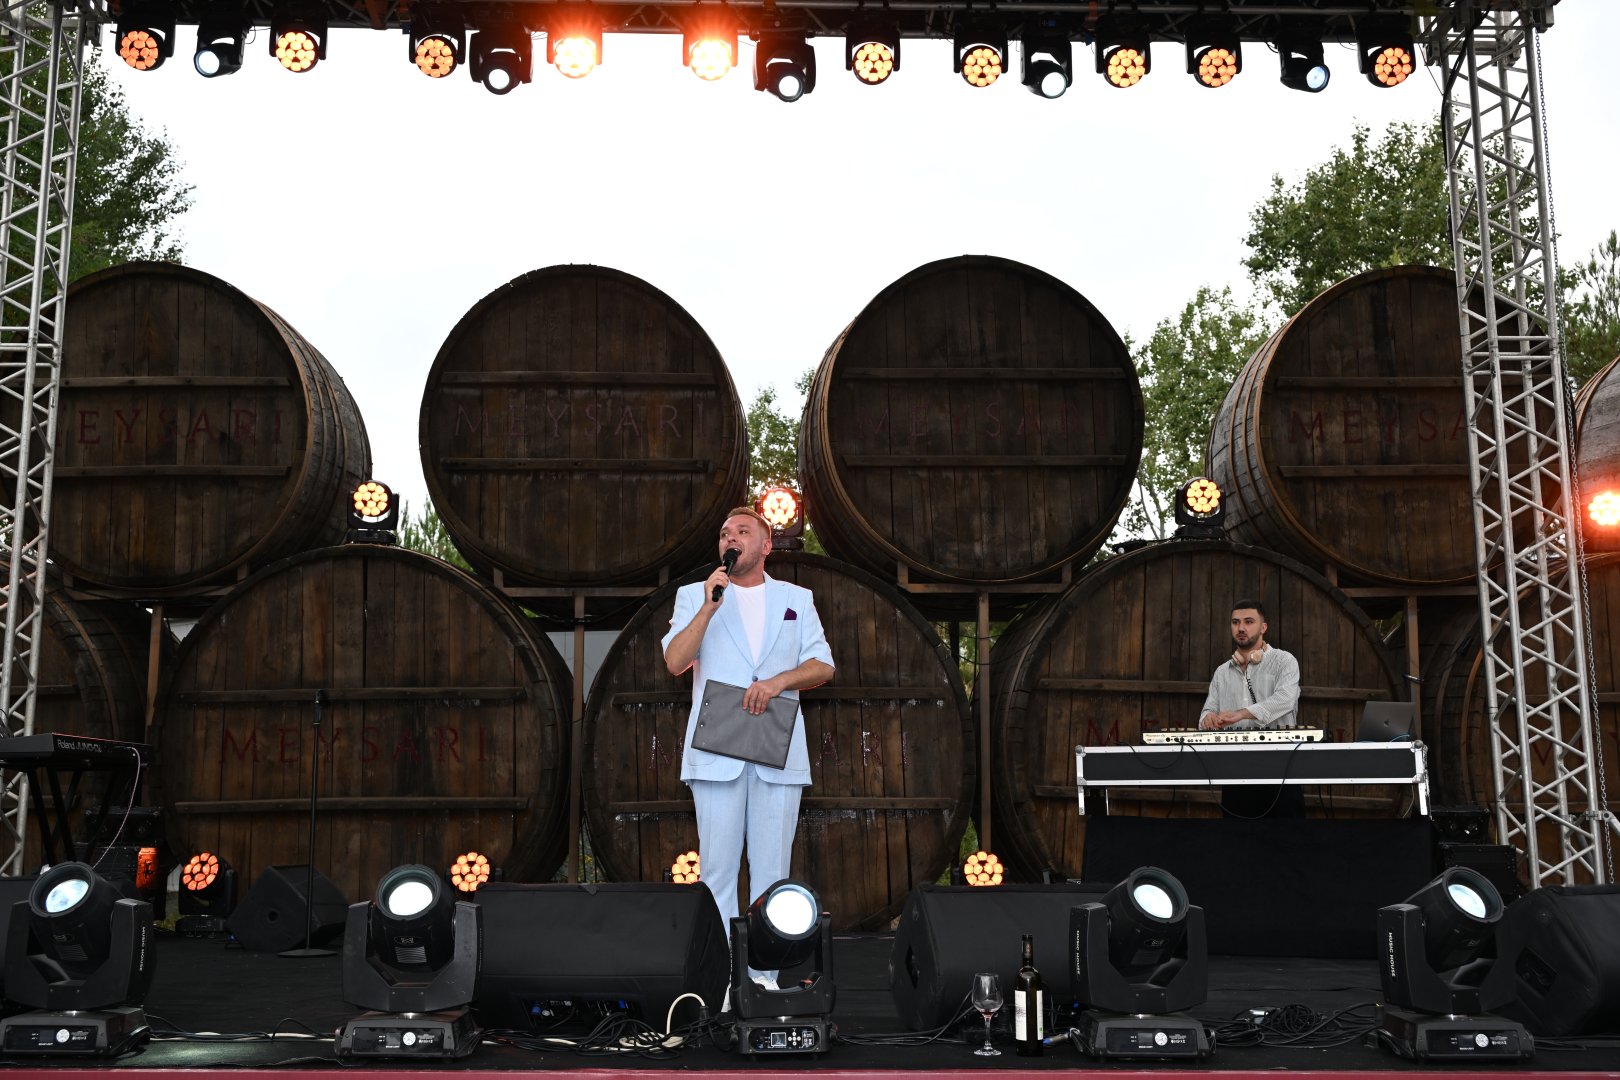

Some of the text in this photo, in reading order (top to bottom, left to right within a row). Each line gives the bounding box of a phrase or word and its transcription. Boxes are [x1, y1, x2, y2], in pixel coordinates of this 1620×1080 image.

[55, 407, 284, 447] EYSARI
[453, 400, 706, 438] MEYSARI
[218, 726, 487, 763] MEYSARI
[649, 729, 911, 768] MARI
